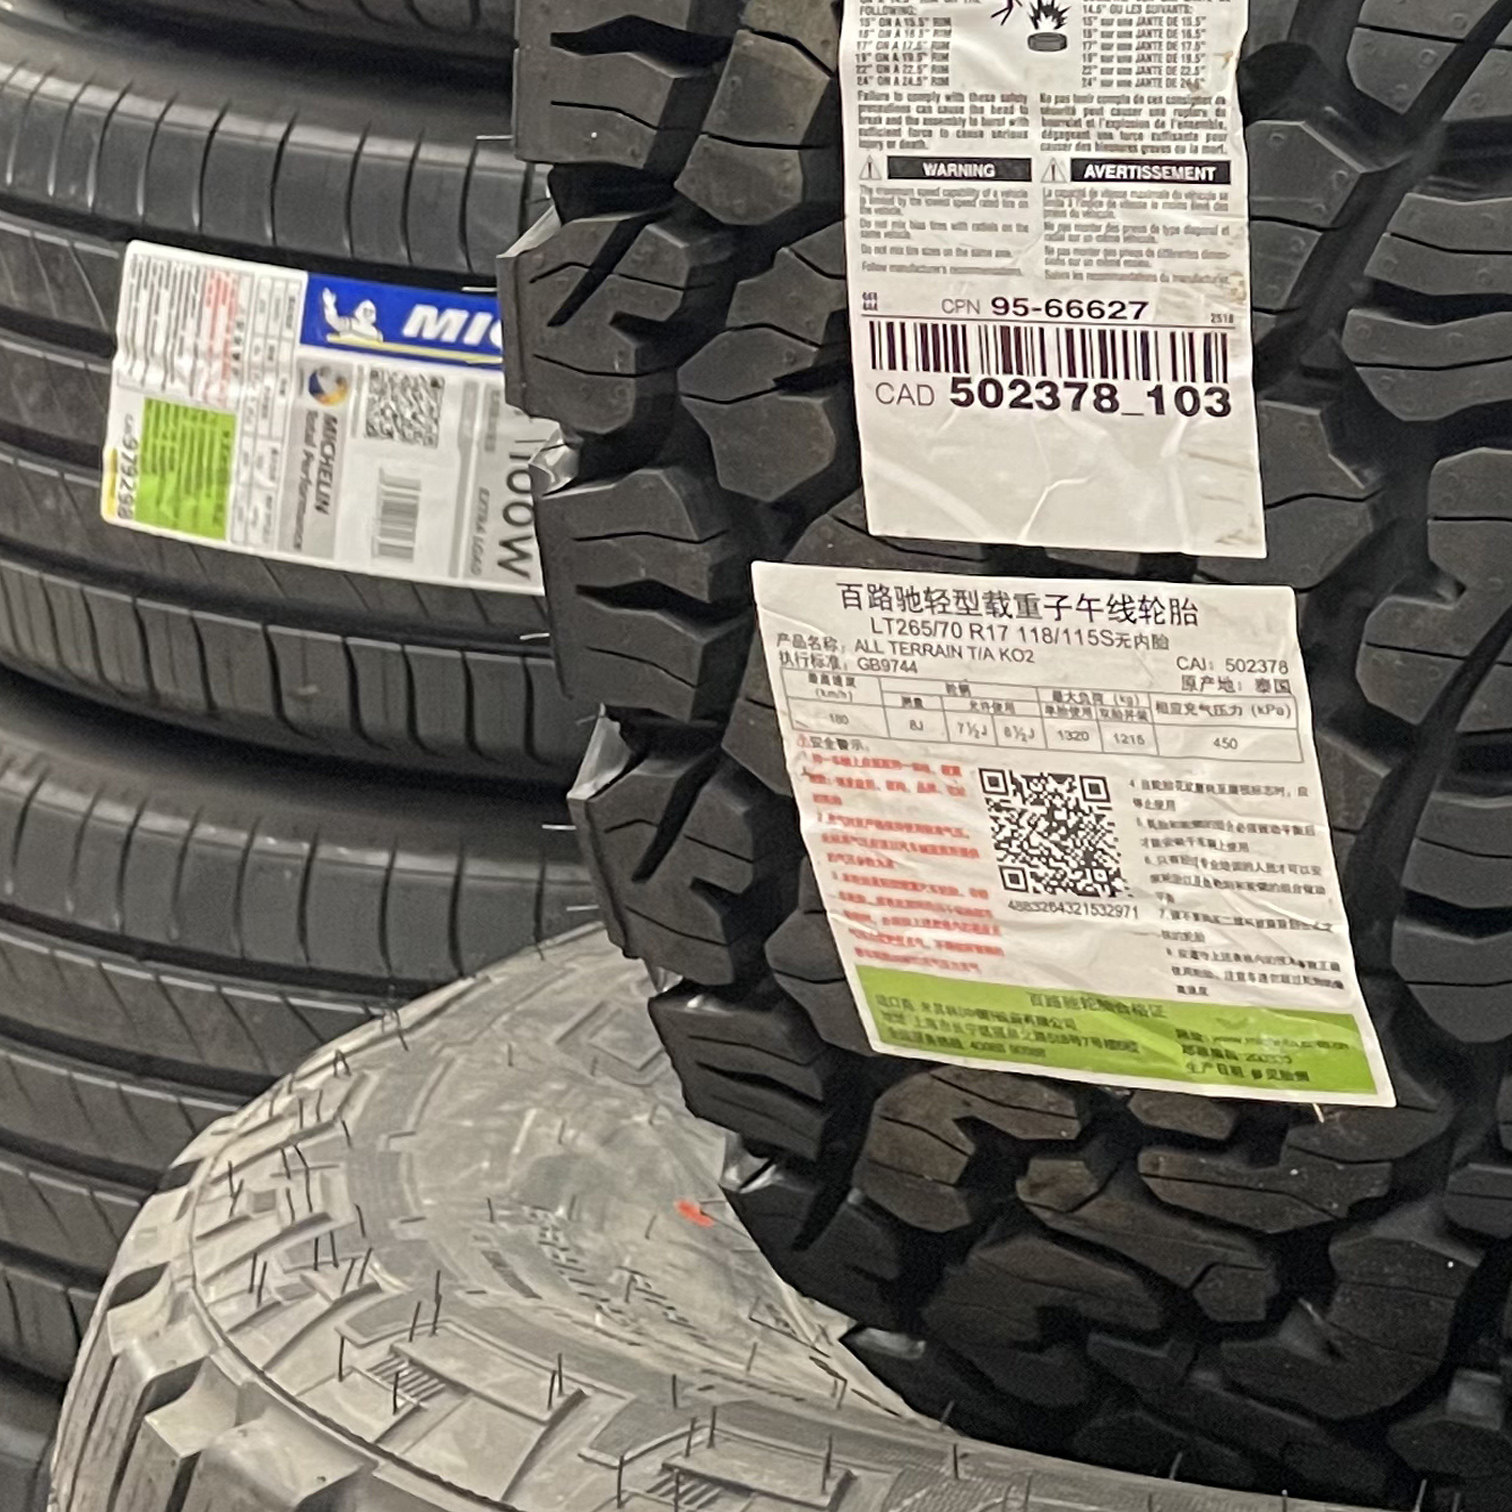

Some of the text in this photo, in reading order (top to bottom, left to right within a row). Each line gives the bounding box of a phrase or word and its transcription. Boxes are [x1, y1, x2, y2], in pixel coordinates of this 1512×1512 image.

[922, 162, 996, 178] WARNING
[1083, 164, 1217, 181] AVERTISSEMENT
[940, 296, 1150, 321] CPN 95-66627
[875, 377, 1232, 418] CAD 502378_103
[315, 413, 337, 515] MICHELIN
[837, 582, 1198, 626] 百路驰轻型载重子午线轮胎
[870, 617, 962, 639] LT265/70
[970, 624, 1009, 640] R17
[855, 639, 884, 654] ALL
[889, 641, 963, 659] TERRAIN
[968, 646, 995, 661] T/A
[1000, 648, 1035, 663] KO2
[857, 657, 918, 673] GB9744
[1225, 658, 1289, 674] 502378
[1213, 738, 1237, 749] 450
